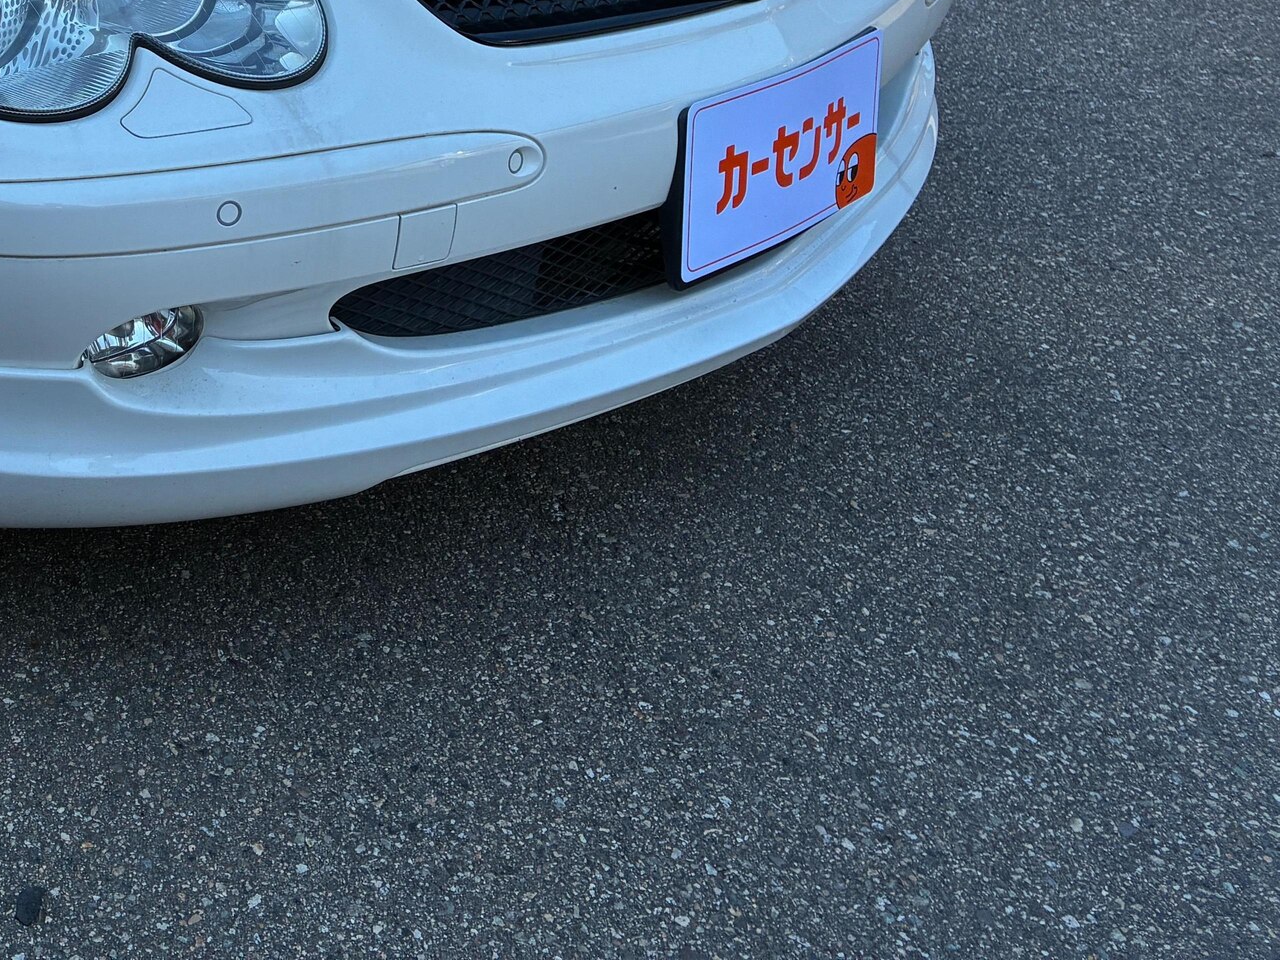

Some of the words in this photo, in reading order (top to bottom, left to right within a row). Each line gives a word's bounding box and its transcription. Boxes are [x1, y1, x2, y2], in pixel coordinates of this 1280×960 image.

[715, 96, 861, 215] カーセンサー
